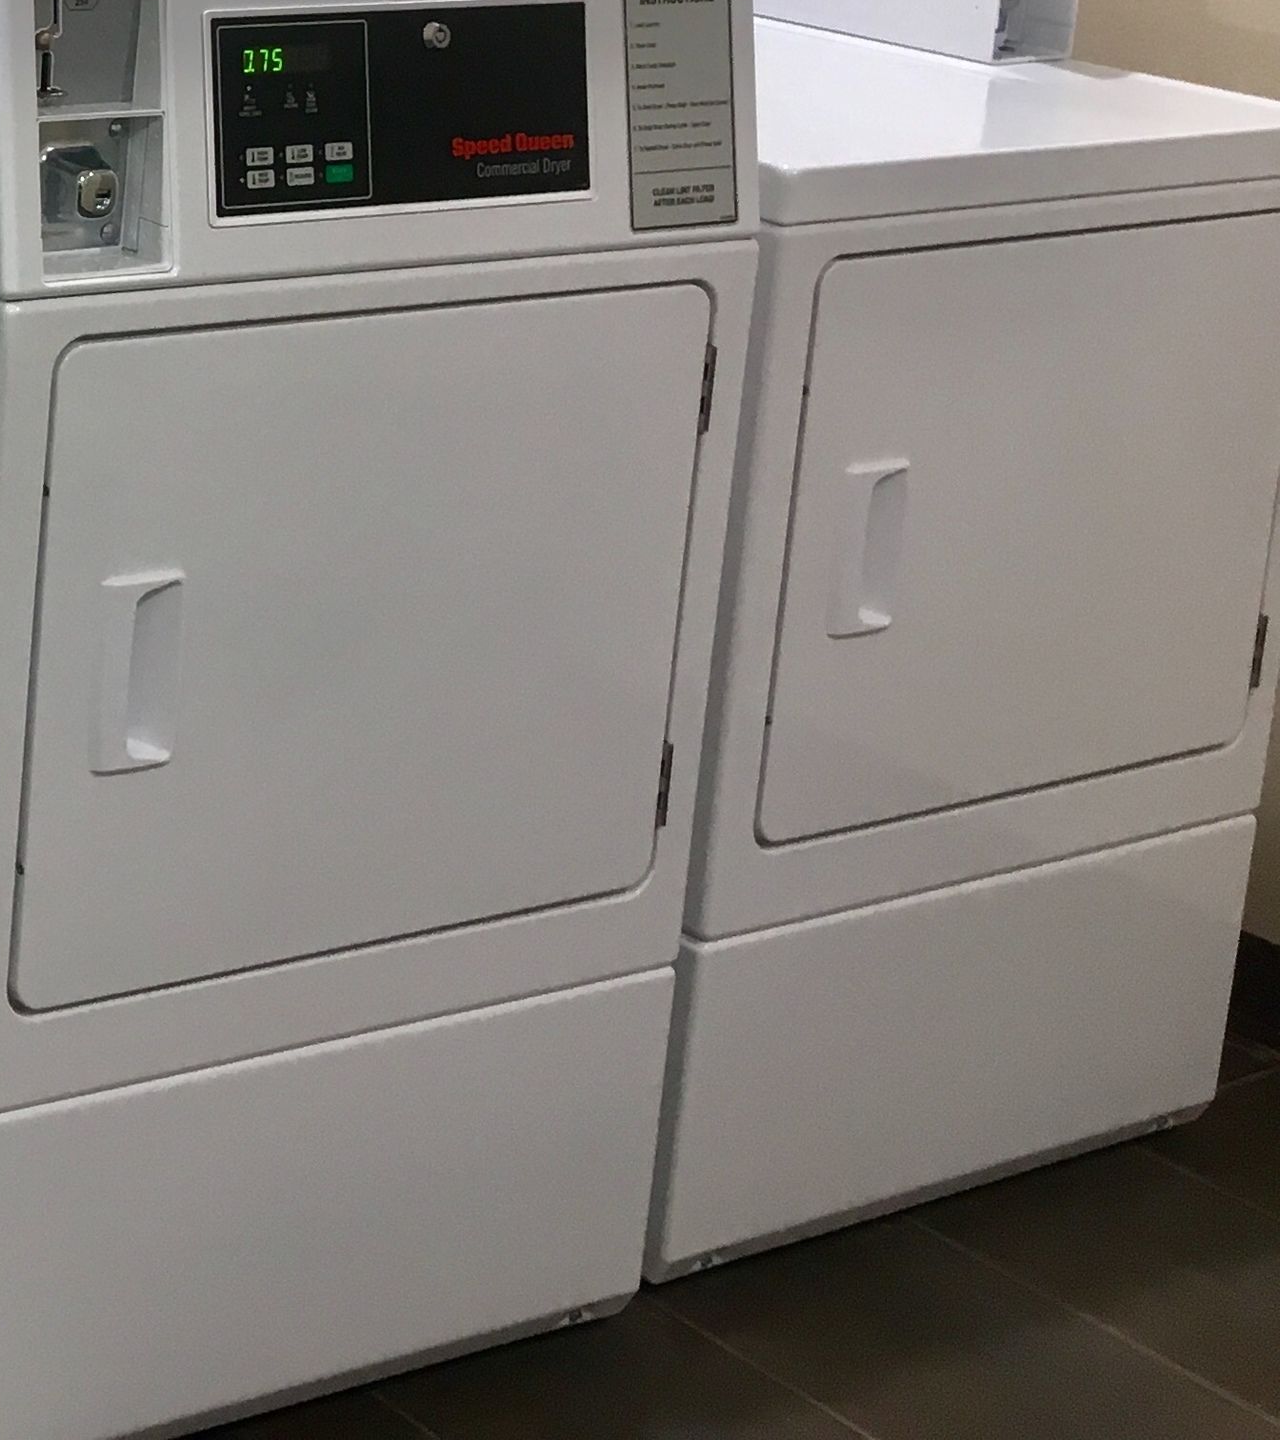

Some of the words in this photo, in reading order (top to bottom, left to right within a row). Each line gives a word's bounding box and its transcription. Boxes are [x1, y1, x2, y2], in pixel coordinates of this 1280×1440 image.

[452, 133, 512, 160] Speed
[516, 133, 574, 151] Queen
[477, 160, 539, 177] Commercial
[543, 158, 571, 175] Dryer
